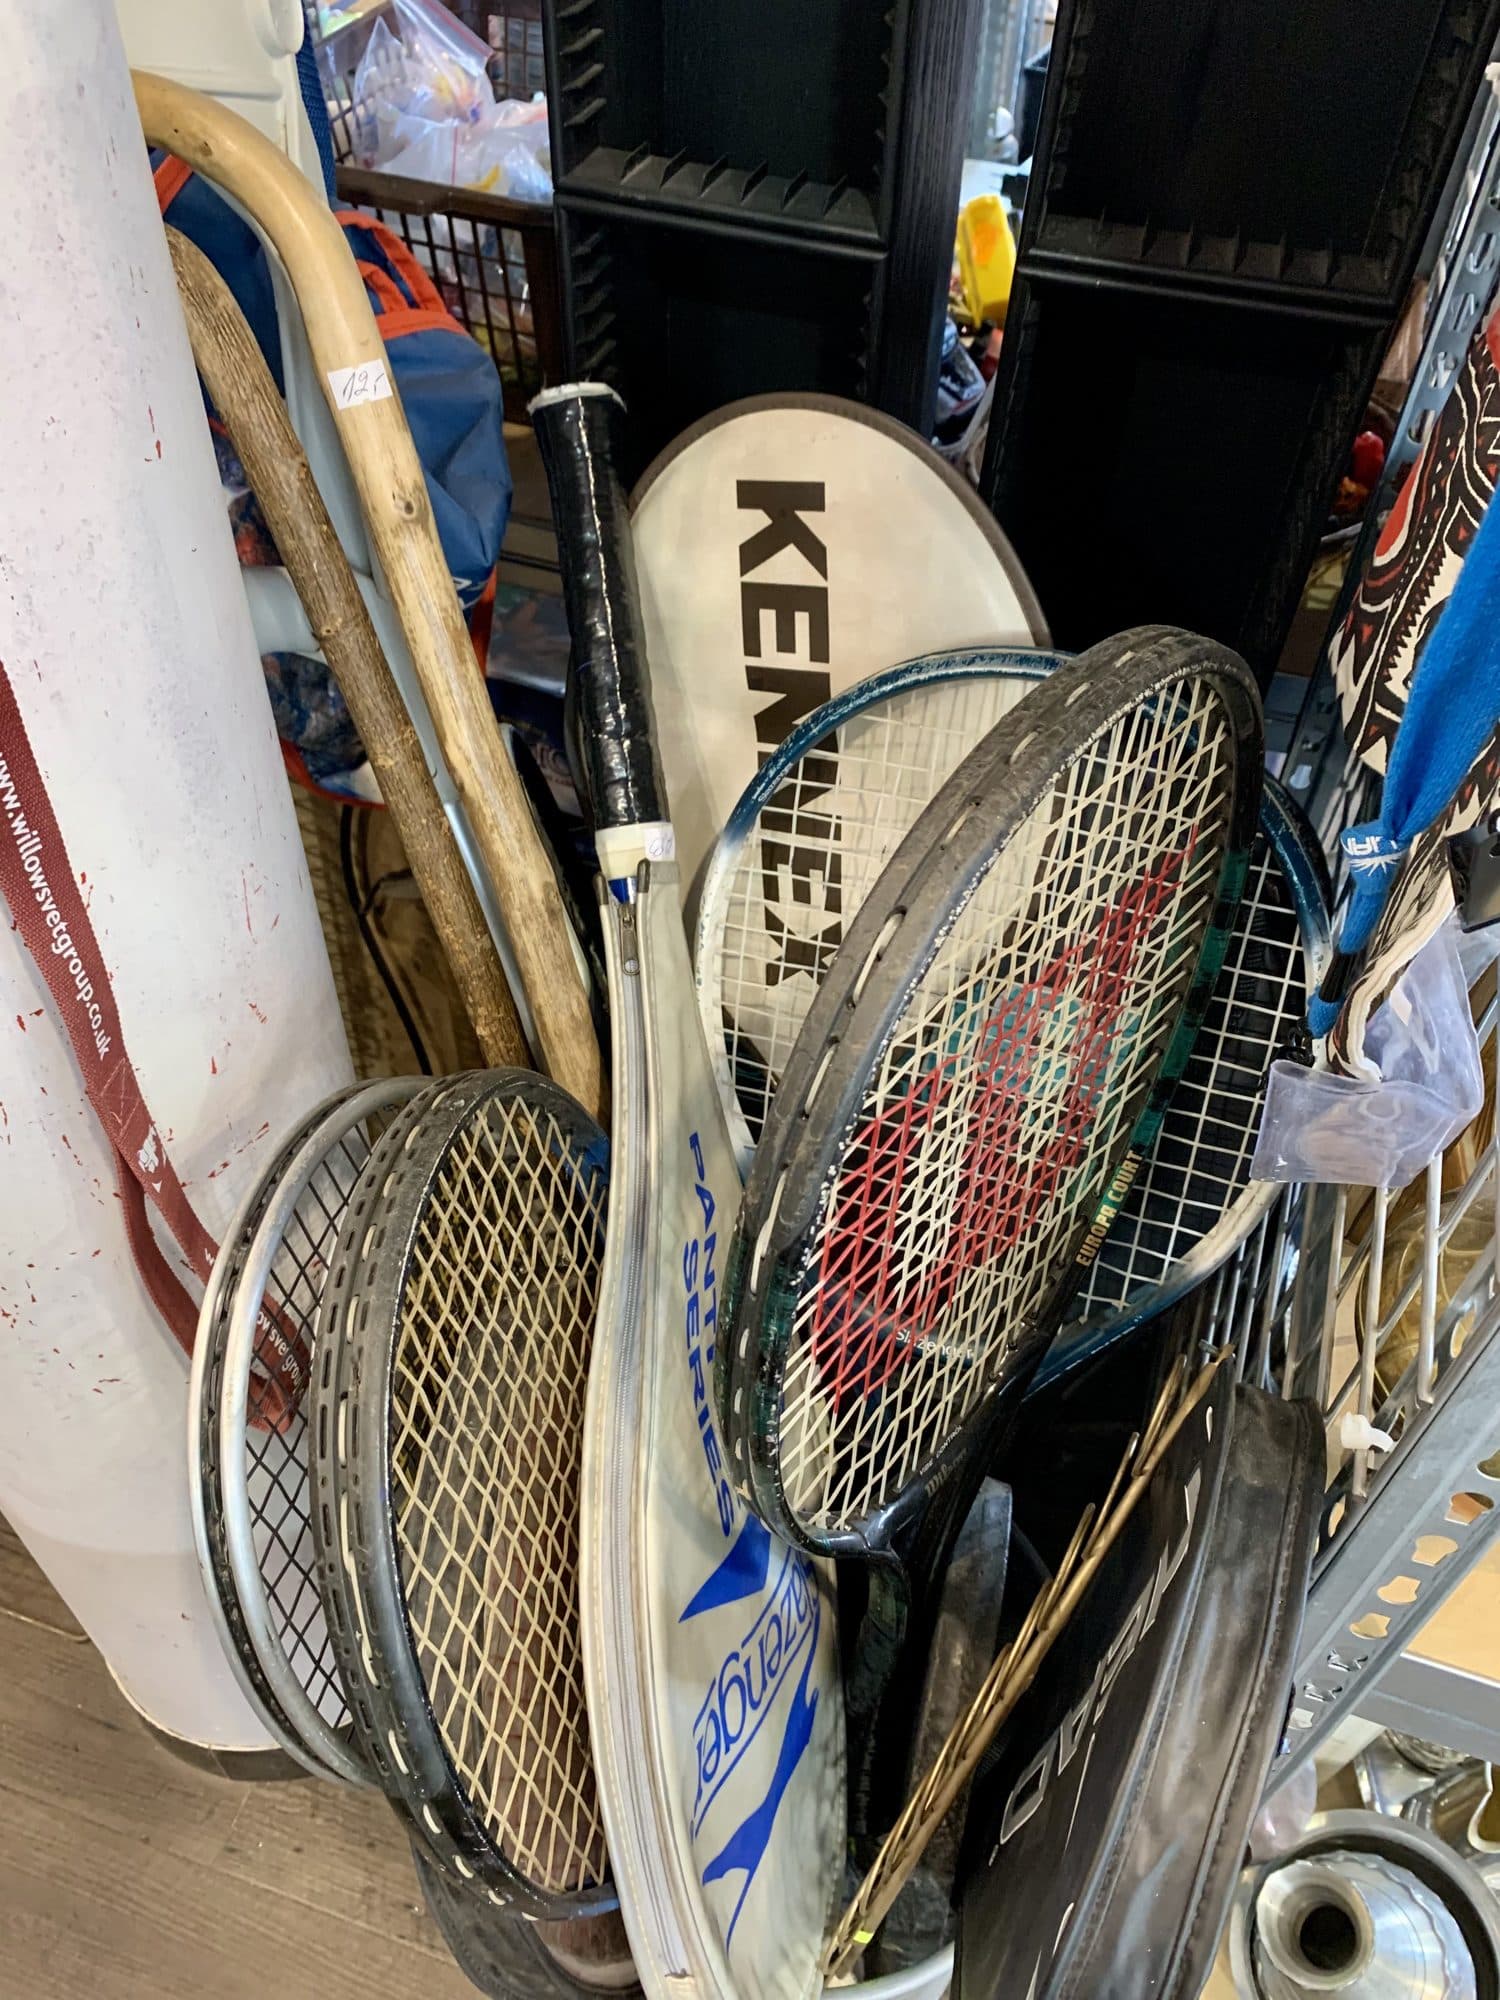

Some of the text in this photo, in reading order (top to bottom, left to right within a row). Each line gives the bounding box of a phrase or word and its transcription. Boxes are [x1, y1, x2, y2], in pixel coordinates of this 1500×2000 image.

[736, 480, 843, 987] KENNEX
[0, 752, 111, 1061] ww.willowsvetgroup.co.uk
[689, 1132, 717, 1363] PANT
[1075, 1149, 1143, 1266] EUROPA COURT
[683, 1238, 735, 1538] SERIES
